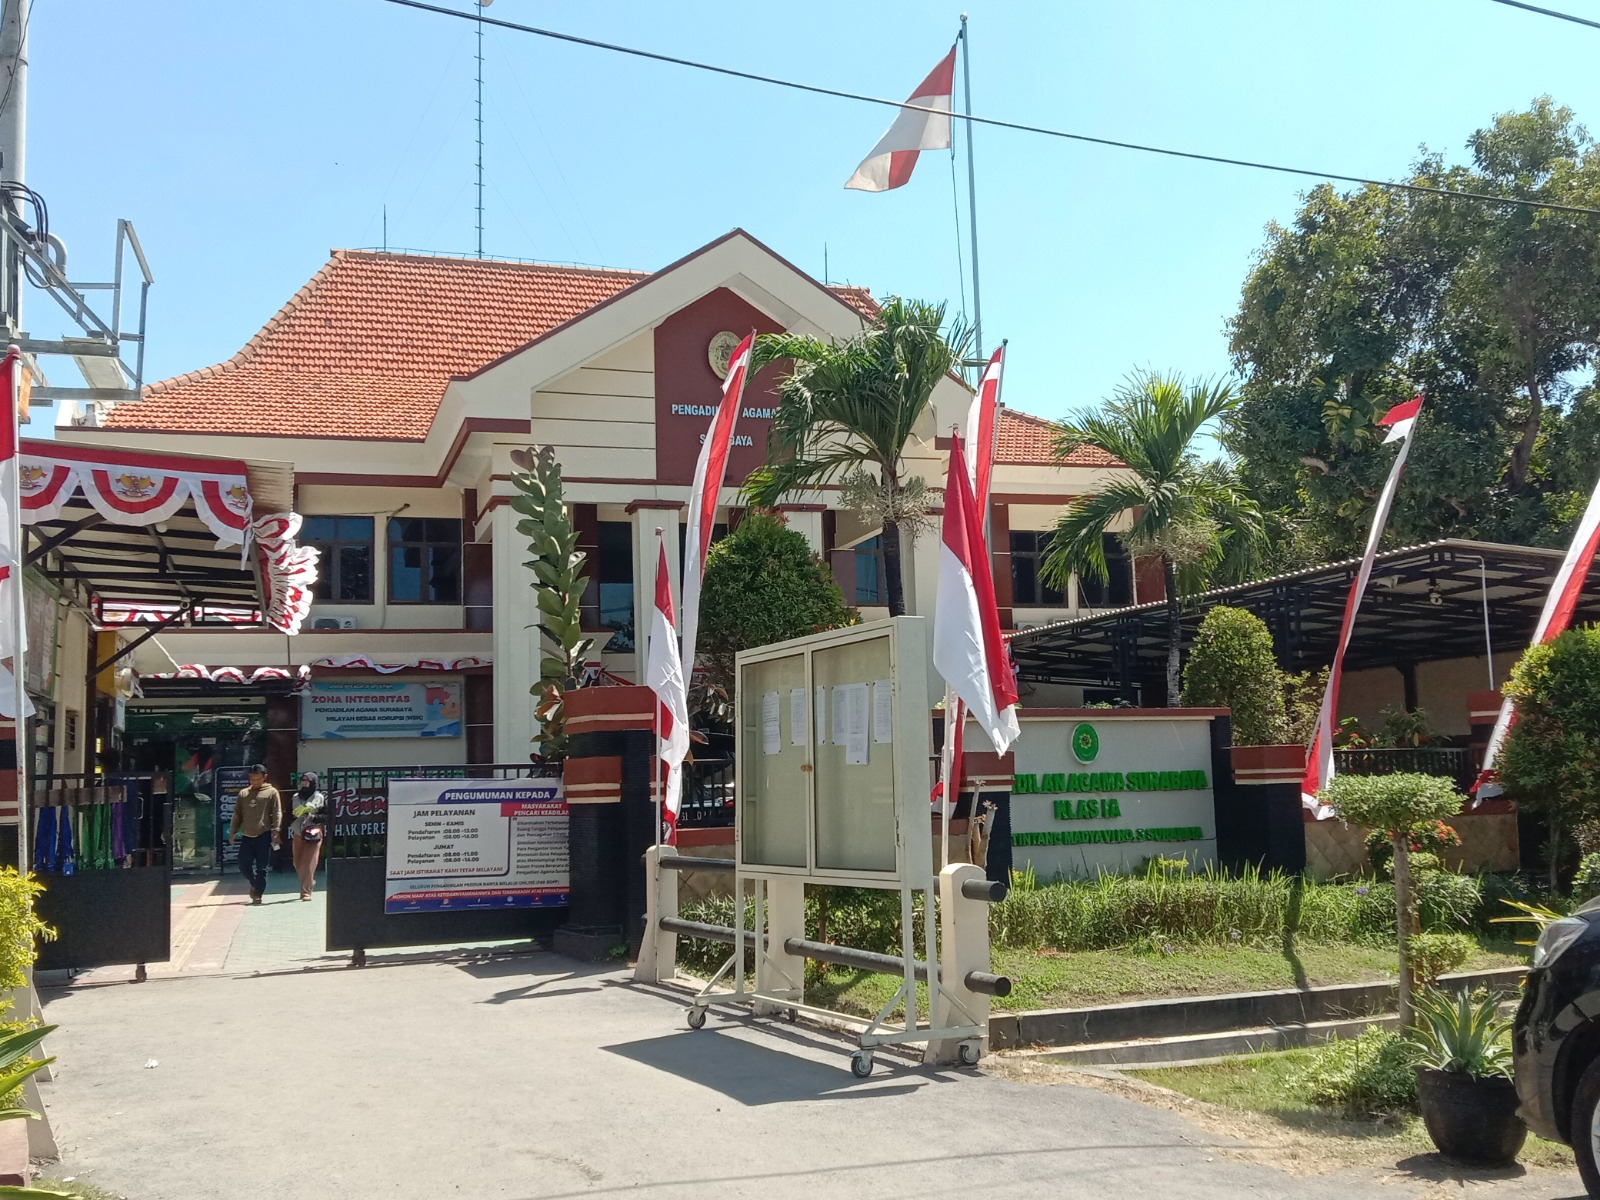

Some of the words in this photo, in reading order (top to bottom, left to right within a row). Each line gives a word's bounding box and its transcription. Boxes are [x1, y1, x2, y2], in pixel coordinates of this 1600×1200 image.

[311, 696, 342, 704] ZONA
[345, 695, 410, 704] INTEGRITAS
[1012, 773, 1065, 793] DILAN
[1066, 772, 1125, 793] AGAMA
[1126, 769, 1208, 791] SURABAYA
[445, 792, 514, 800] PENGUMUMAN
[515, 791, 551, 800] KEPADA
[412, 810, 428, 818] JAM
[1053, 799, 1099, 820] KLAS
